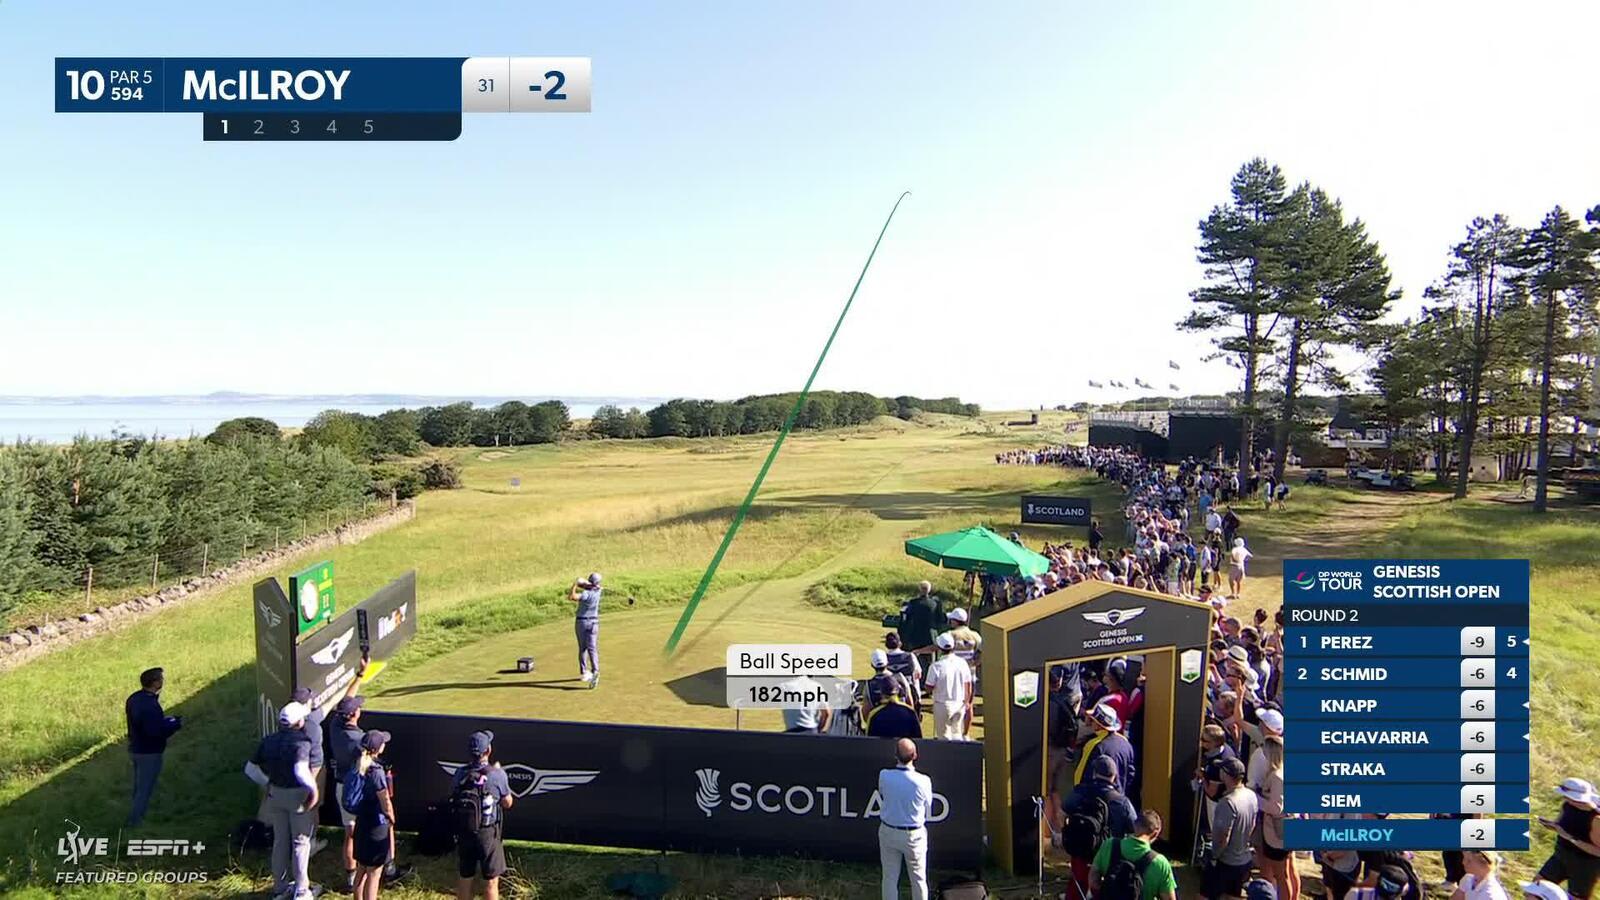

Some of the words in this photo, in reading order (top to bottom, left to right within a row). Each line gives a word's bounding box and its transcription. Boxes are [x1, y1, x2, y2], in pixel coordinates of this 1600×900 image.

[1035, 505, 1085, 517] SCOTLAND
[1099, 627, 1127, 638] GENESIS
[1082, 637, 1116, 649] SCOTTISH
[1116, 635, 1135, 646] OPEN
[730, 782, 950, 824] SCOTLAD
